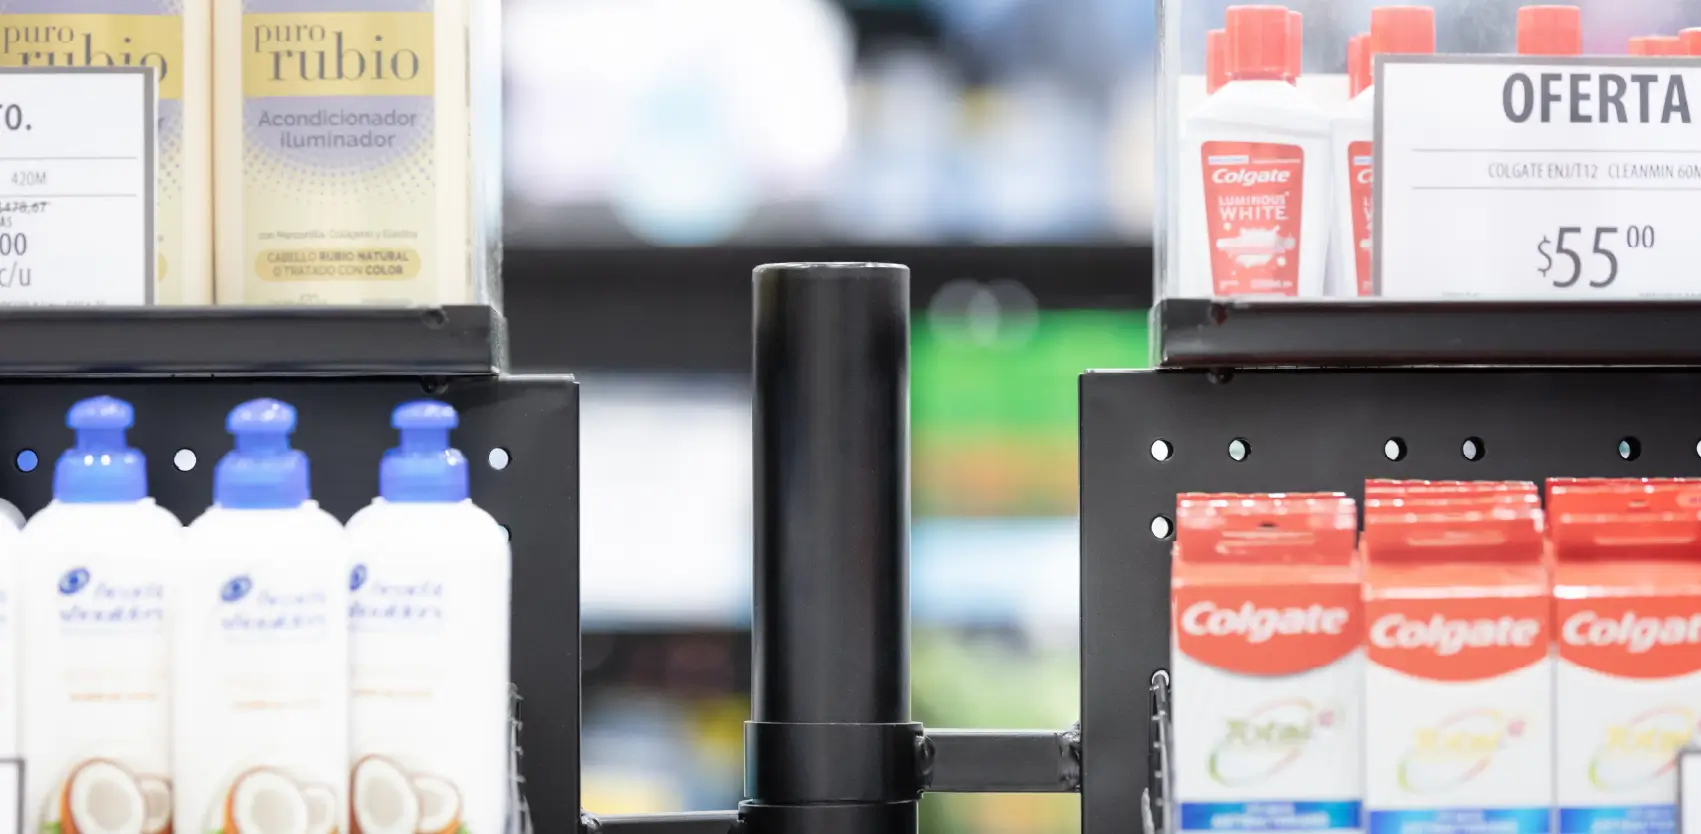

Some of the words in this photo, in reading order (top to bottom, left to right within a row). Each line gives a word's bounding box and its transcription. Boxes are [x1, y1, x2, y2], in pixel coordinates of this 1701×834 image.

[3, 25, 74, 53] puro
[254, 23, 326, 52] puro
[268, 30, 419, 81] rubio
[1502, 72, 1692, 124] OFERTA
[258, 109, 417, 127] Acondicionador
[280, 130, 396, 149] iluminador
[1212, 168, 1291, 187] Colgate
[1488, 162, 1544, 178] COLGATE
[1608, 163, 1674, 179] CLEANMIN
[1218, 194, 1286, 206] LUMINOUS
[0, 216, 13, 228] AS
[1219, 206, 1288, 220] WHITE
[0, 232, 27, 256] 00
[318, 250, 354, 262] RUBIO
[357, 250, 409, 262] NATURAL
[285, 265, 336, 277] TRATADO
[338, 264, 363, 276] CON
[365, 264, 403, 276] COLOR
[1181, 600, 1348, 643] Colgate
[1369, 612, 1540, 656] Colgate
[1562, 610, 1701, 654] Colgat
